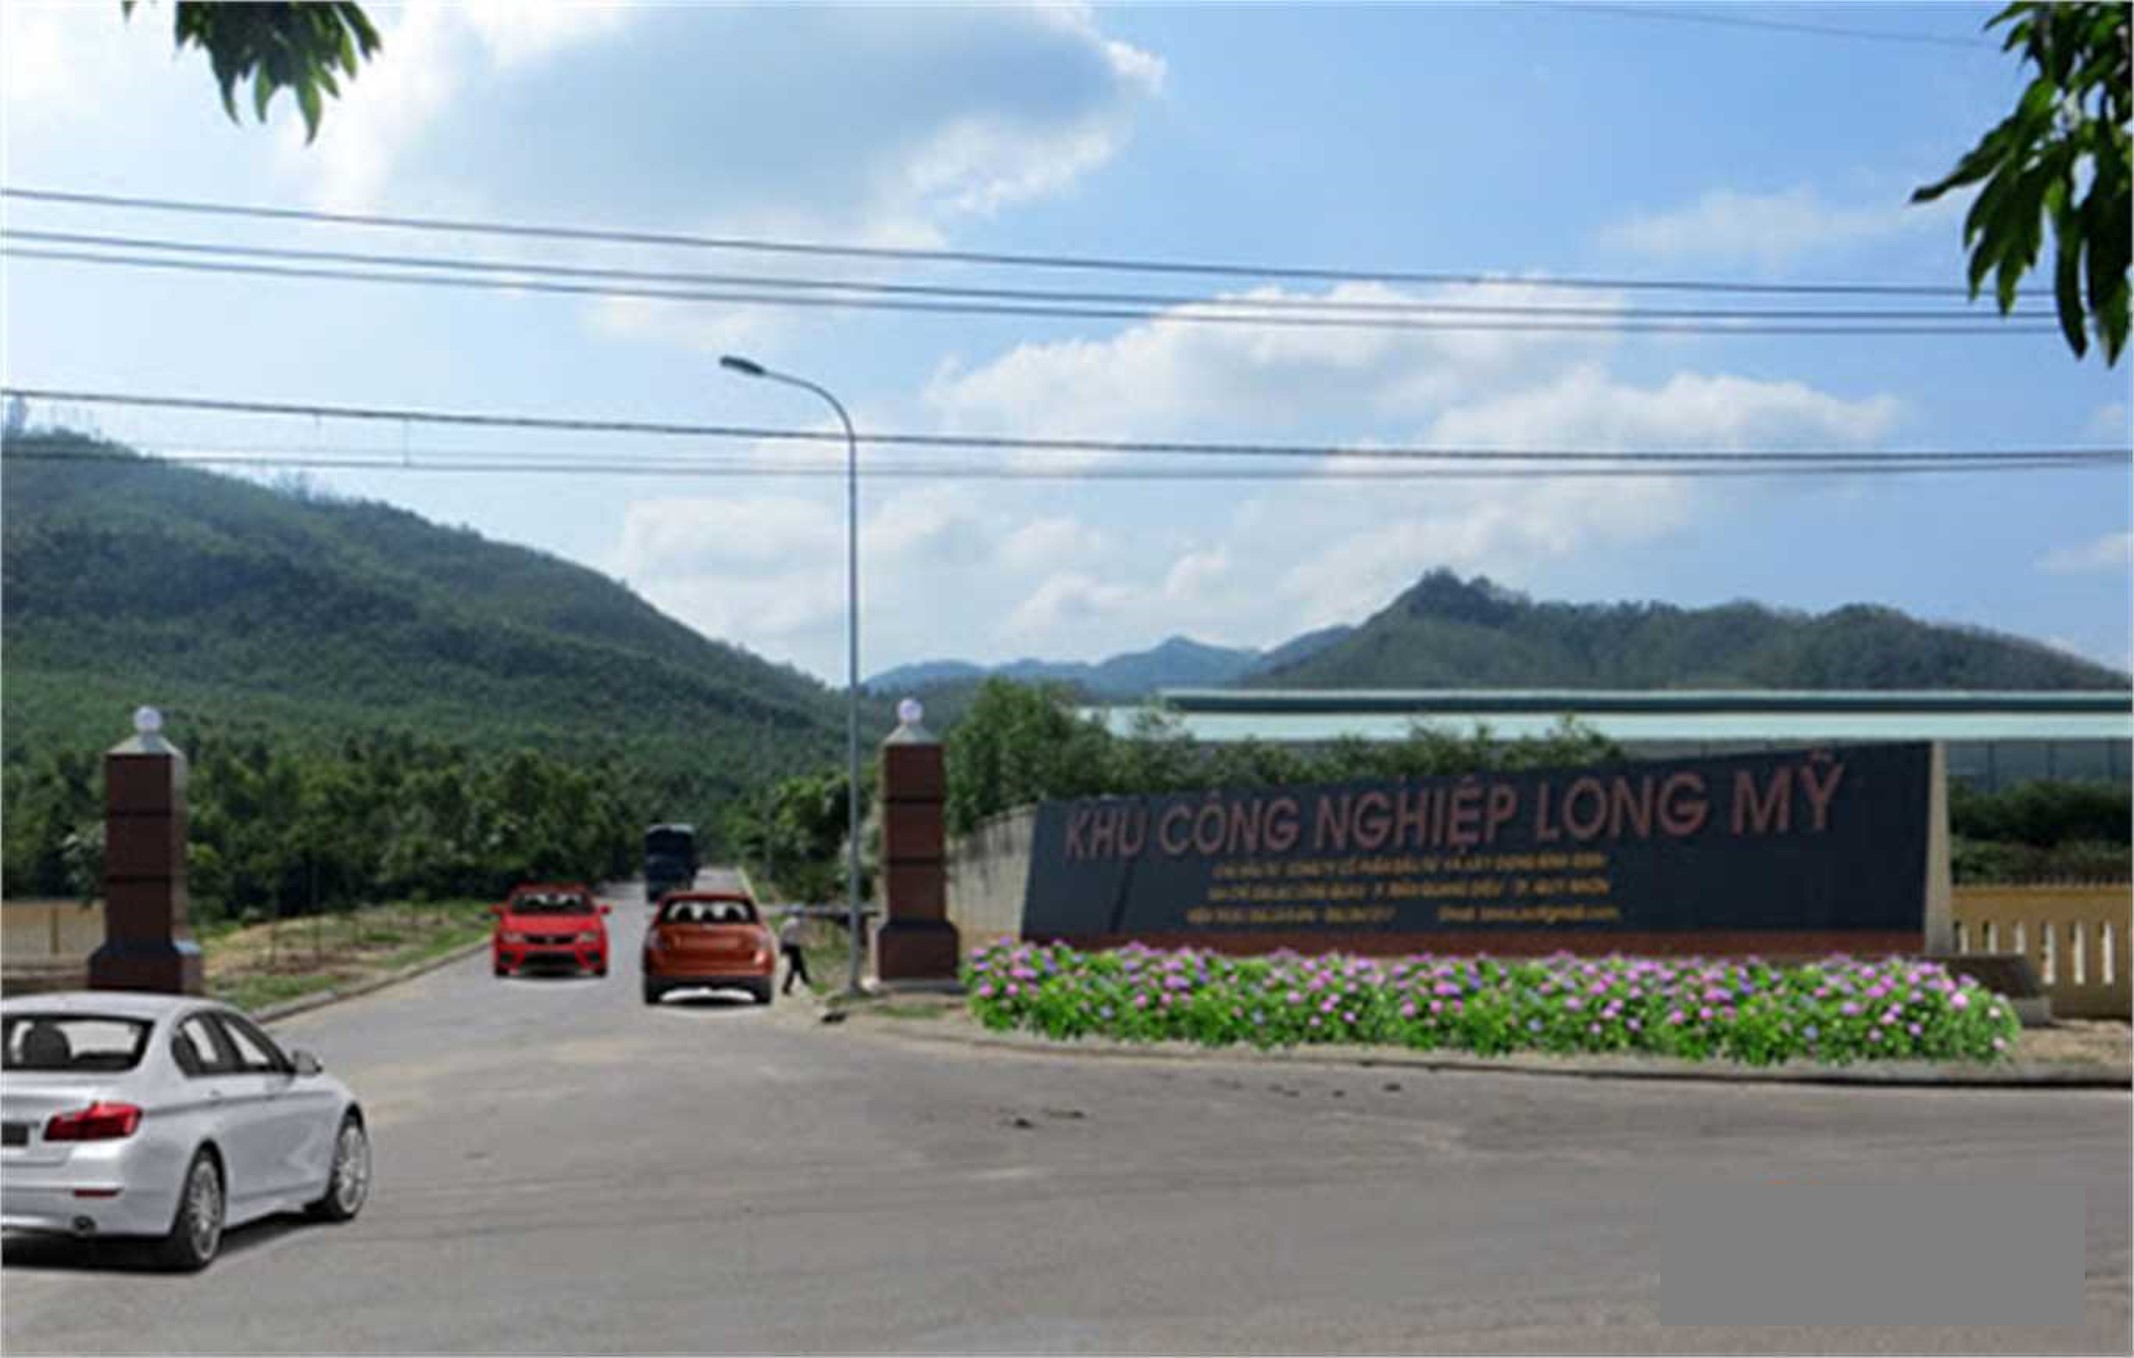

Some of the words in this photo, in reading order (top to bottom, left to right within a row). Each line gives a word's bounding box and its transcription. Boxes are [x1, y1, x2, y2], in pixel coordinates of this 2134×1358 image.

[1063, 806, 1147, 859] KHU
[1158, 791, 1299, 855] CÔNG
[1314, 776, 1517, 855] NGHIỆP
[1536, 772, 1708, 842] LONG
[1731, 749, 1844, 835] MỸ
